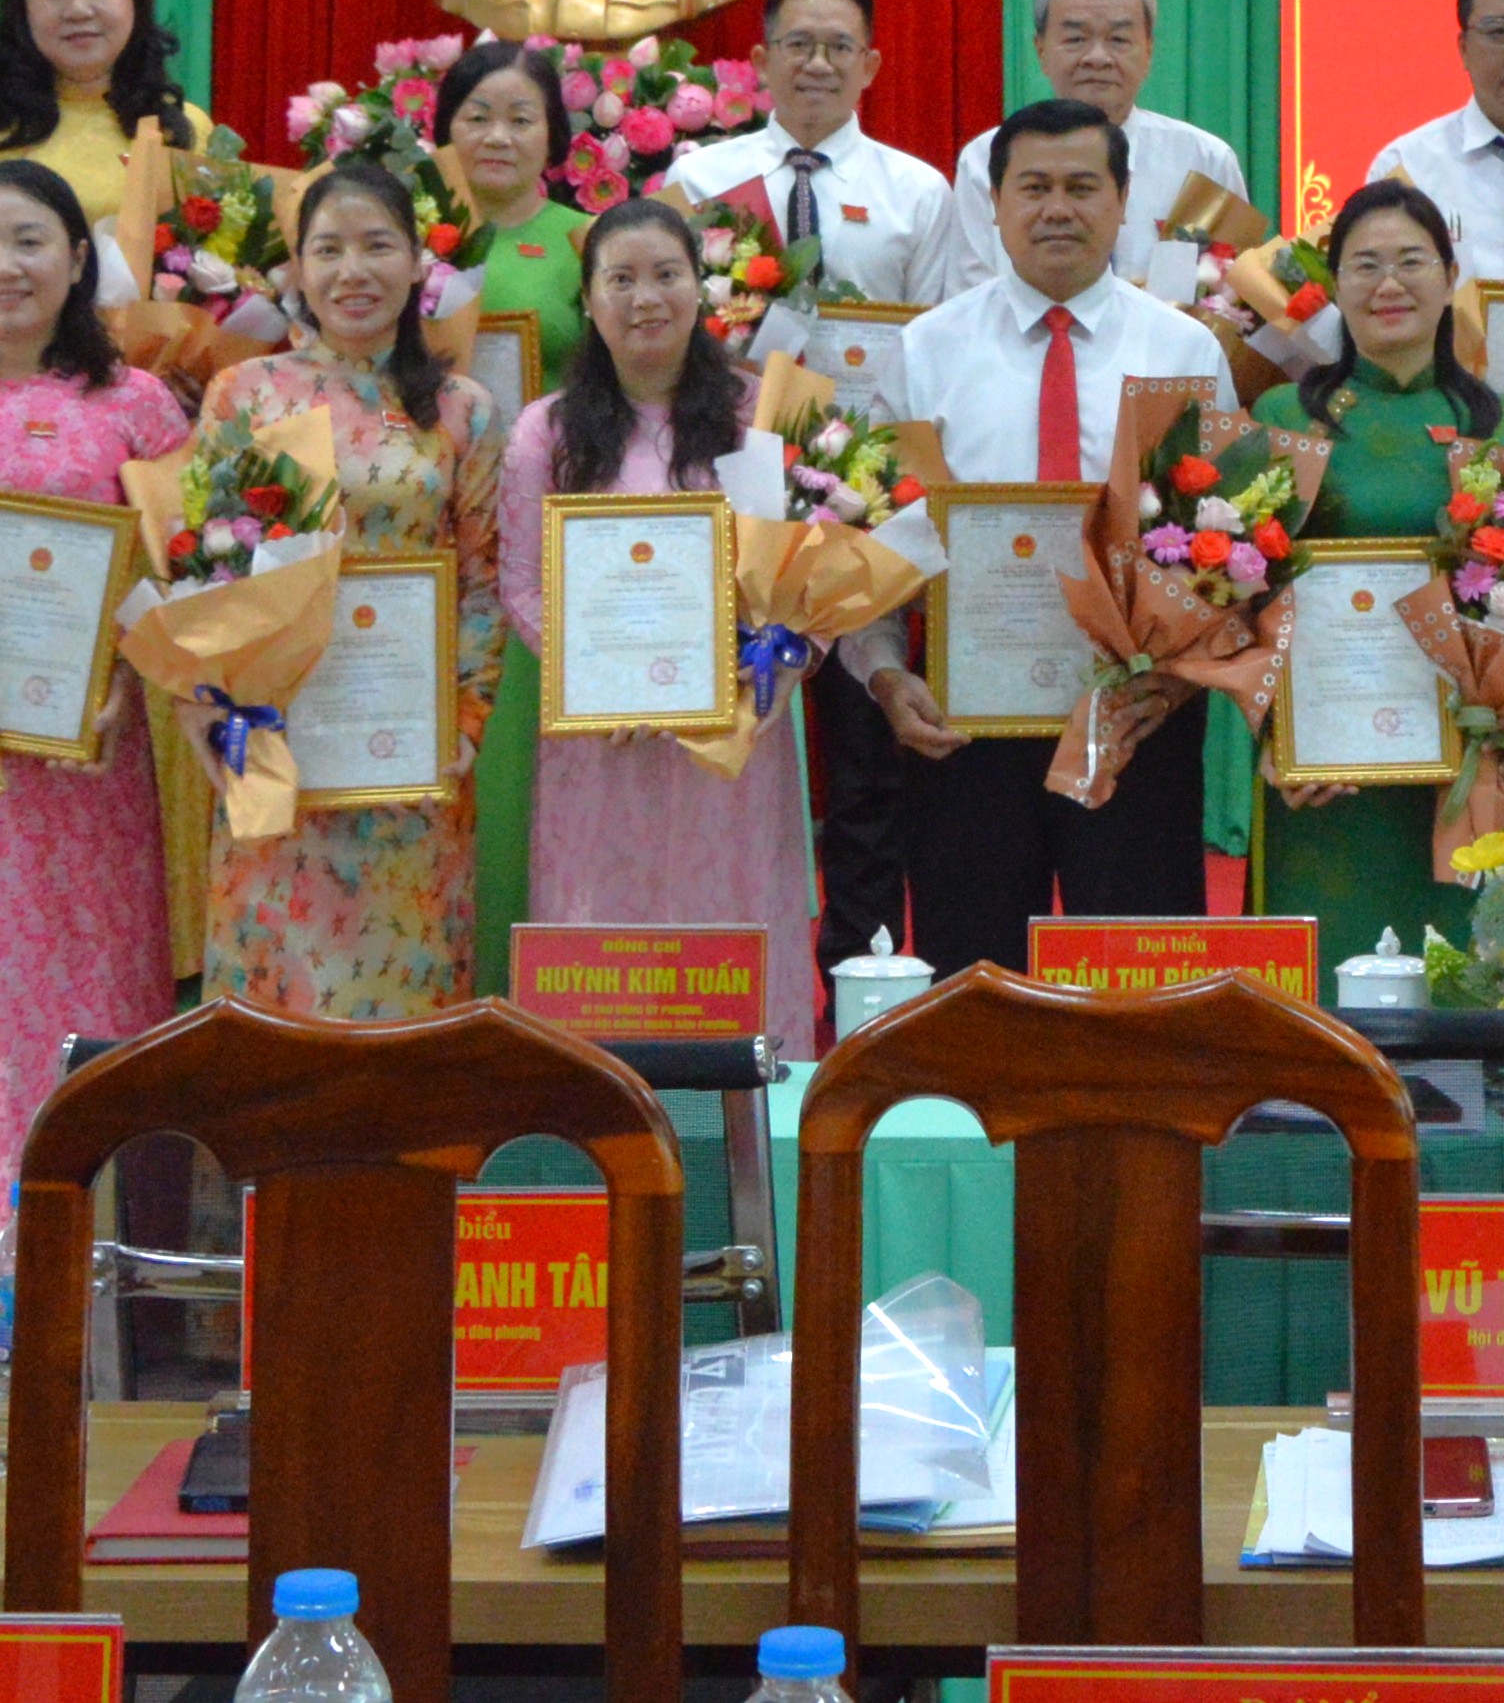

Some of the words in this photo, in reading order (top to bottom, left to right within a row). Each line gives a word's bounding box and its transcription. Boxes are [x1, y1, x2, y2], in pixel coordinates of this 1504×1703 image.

[1136, 936, 1167, 958] Đại
[1170, 934, 1208, 954] biểu
[536, 960, 621, 994] HUỲNH
[628, 967, 677, 994] KIM
[684, 958, 750, 995] TUẤN
[458, 1210, 512, 1240] biểu
[1425, 1261, 1483, 1316] VŨ
[1467, 1329, 1491, 1349] Hội
